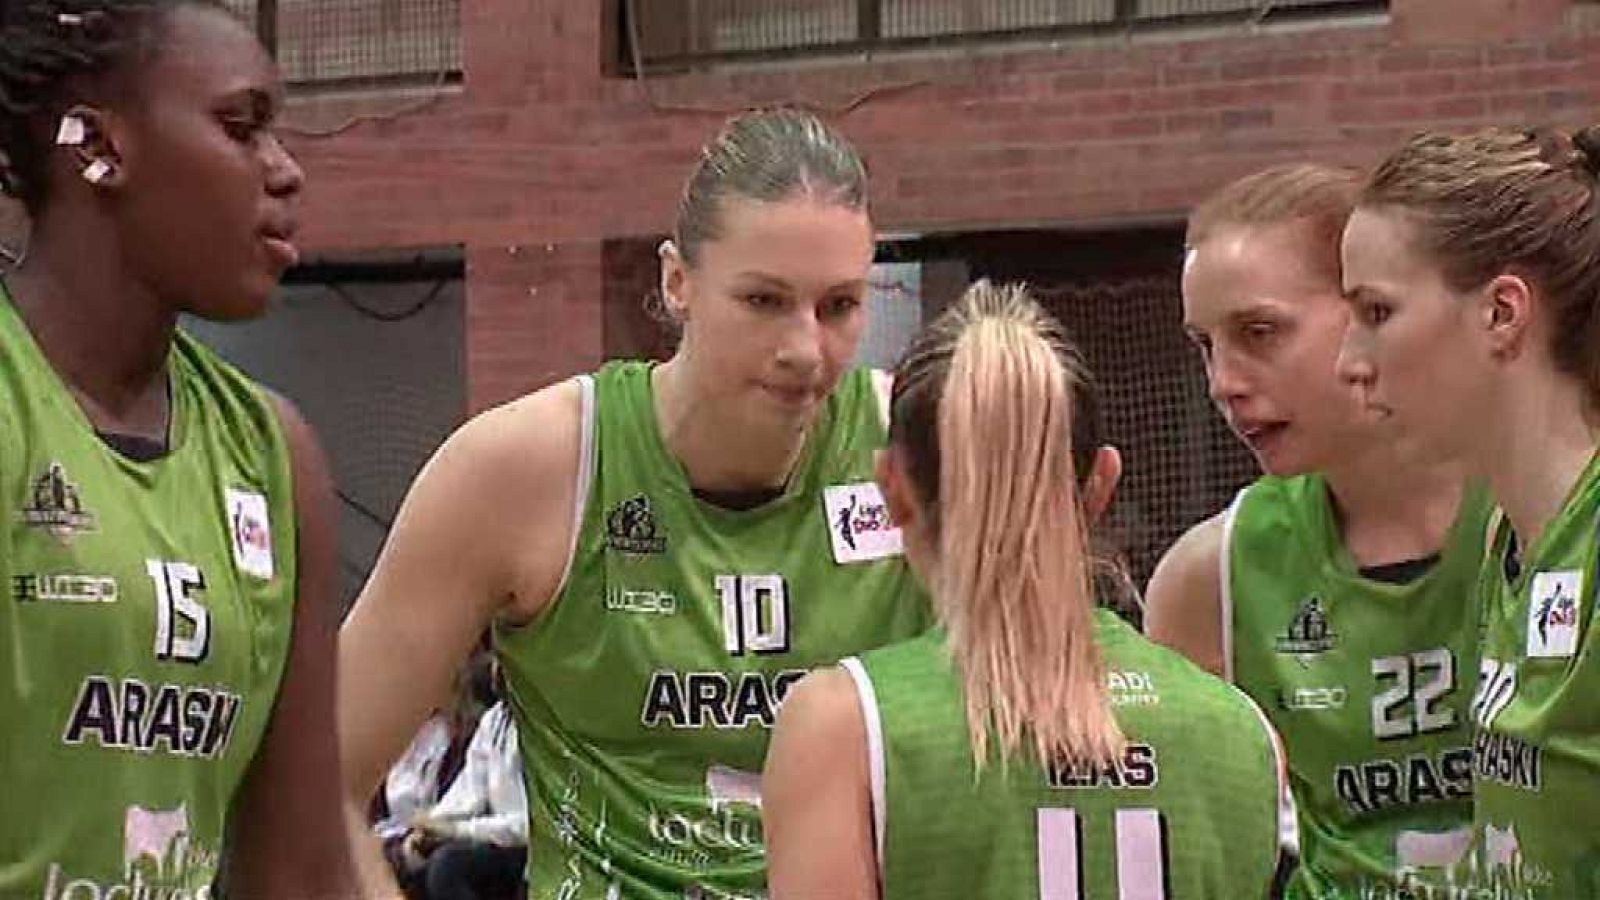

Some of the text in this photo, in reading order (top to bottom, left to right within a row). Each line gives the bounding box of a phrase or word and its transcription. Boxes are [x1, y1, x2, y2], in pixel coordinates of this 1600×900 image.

[146, 558, 212, 664] 15
[715, 573, 789, 656] 10
[1371, 648, 1457, 741] 22
[1036, 807, 1170, 900] 11
